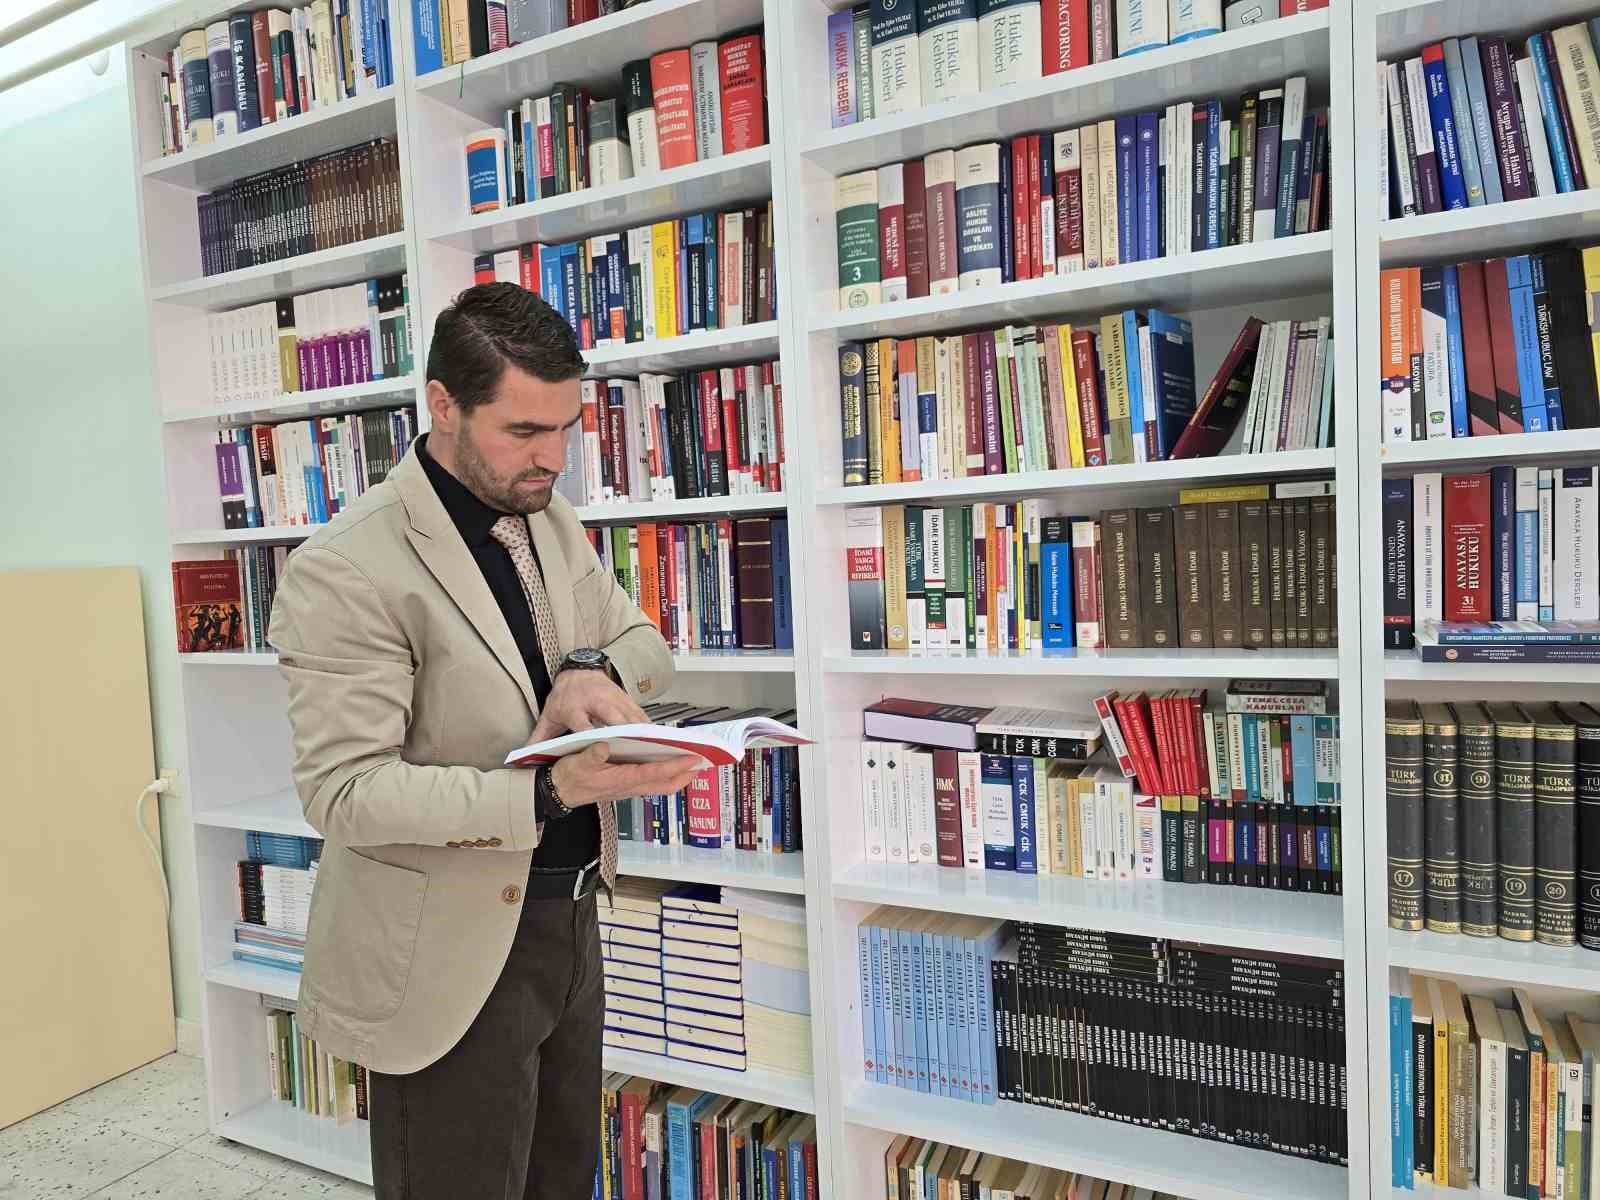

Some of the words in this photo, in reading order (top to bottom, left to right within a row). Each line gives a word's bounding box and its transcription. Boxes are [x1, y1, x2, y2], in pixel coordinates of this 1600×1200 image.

[835, 32, 848, 65] HUKUK
[994, 18, 1007, 74] Rehberi
[1008, 14, 1022, 62] Hukuk
[894, 45, 908, 91] Hukuk
[932, 33, 944, 88] Rehberi
[946, 30, 960, 78] Hukuk
[235, 54, 247, 111] KANUNU
[880, 48, 895, 102] Rehberi
[1500, 101, 1512, 130] Avrupa
[1506, 130, 1518, 154] İnsan
[1209, 147, 1217, 176] TİCARET
[1510, 154, 1521, 187] Hakları
[1208, 178, 1217, 208] HUKUKU
[972, 235, 982, 244] VE
[565, 262, 574, 285] SULH
[852, 266, 862, 281] 3
[567, 286, 575, 307] CEZA
[1537, 304, 1547, 332] TURKISH
[1540, 333, 1550, 361] PUBLIC
[984, 368, 993, 393] TÜRK
[1413, 356, 1421, 393] ELKOYMA
[1544, 362, 1553, 378] LAW
[986, 394, 995, 423] HUKUK
[989, 425, 997, 454] TARİHİ
[931, 514, 940, 544] İDARE
[1574, 497, 1583, 533] ANAYASA
[1397, 519, 1406, 560] ANAYASA
[1575, 536, 1583, 569] HUKUKU
[932, 545, 940, 574] HUKUKU
[1457, 536, 1466, 590] ANAYASA
[1468, 536, 1479, 590] HUKUKU
[1398, 561, 1407, 600] HUKUKU
[1015, 736, 1025, 753] TCK
[1031, 738, 1041, 755] CMK
[1046, 737, 1057, 758] CGİK
[935, 778, 954, 791] HMK
[1018, 777, 1027, 796] TCK
[1391, 769, 1416, 779] TÜRK
[1503, 774, 1530, 783] TÜRK
[1543, 776, 1571, 786] TÜRK
[692, 798, 711, 810] CEZA
[1020, 803, 1029, 830] CMUK
[689, 816, 718, 831] KANUNU
[1398, 873, 1409, 883] 17
[1431, 877, 1457, 887] TÜRK
[1508, 882, 1522, 891] 19
[1548, 886, 1563, 895] 20
